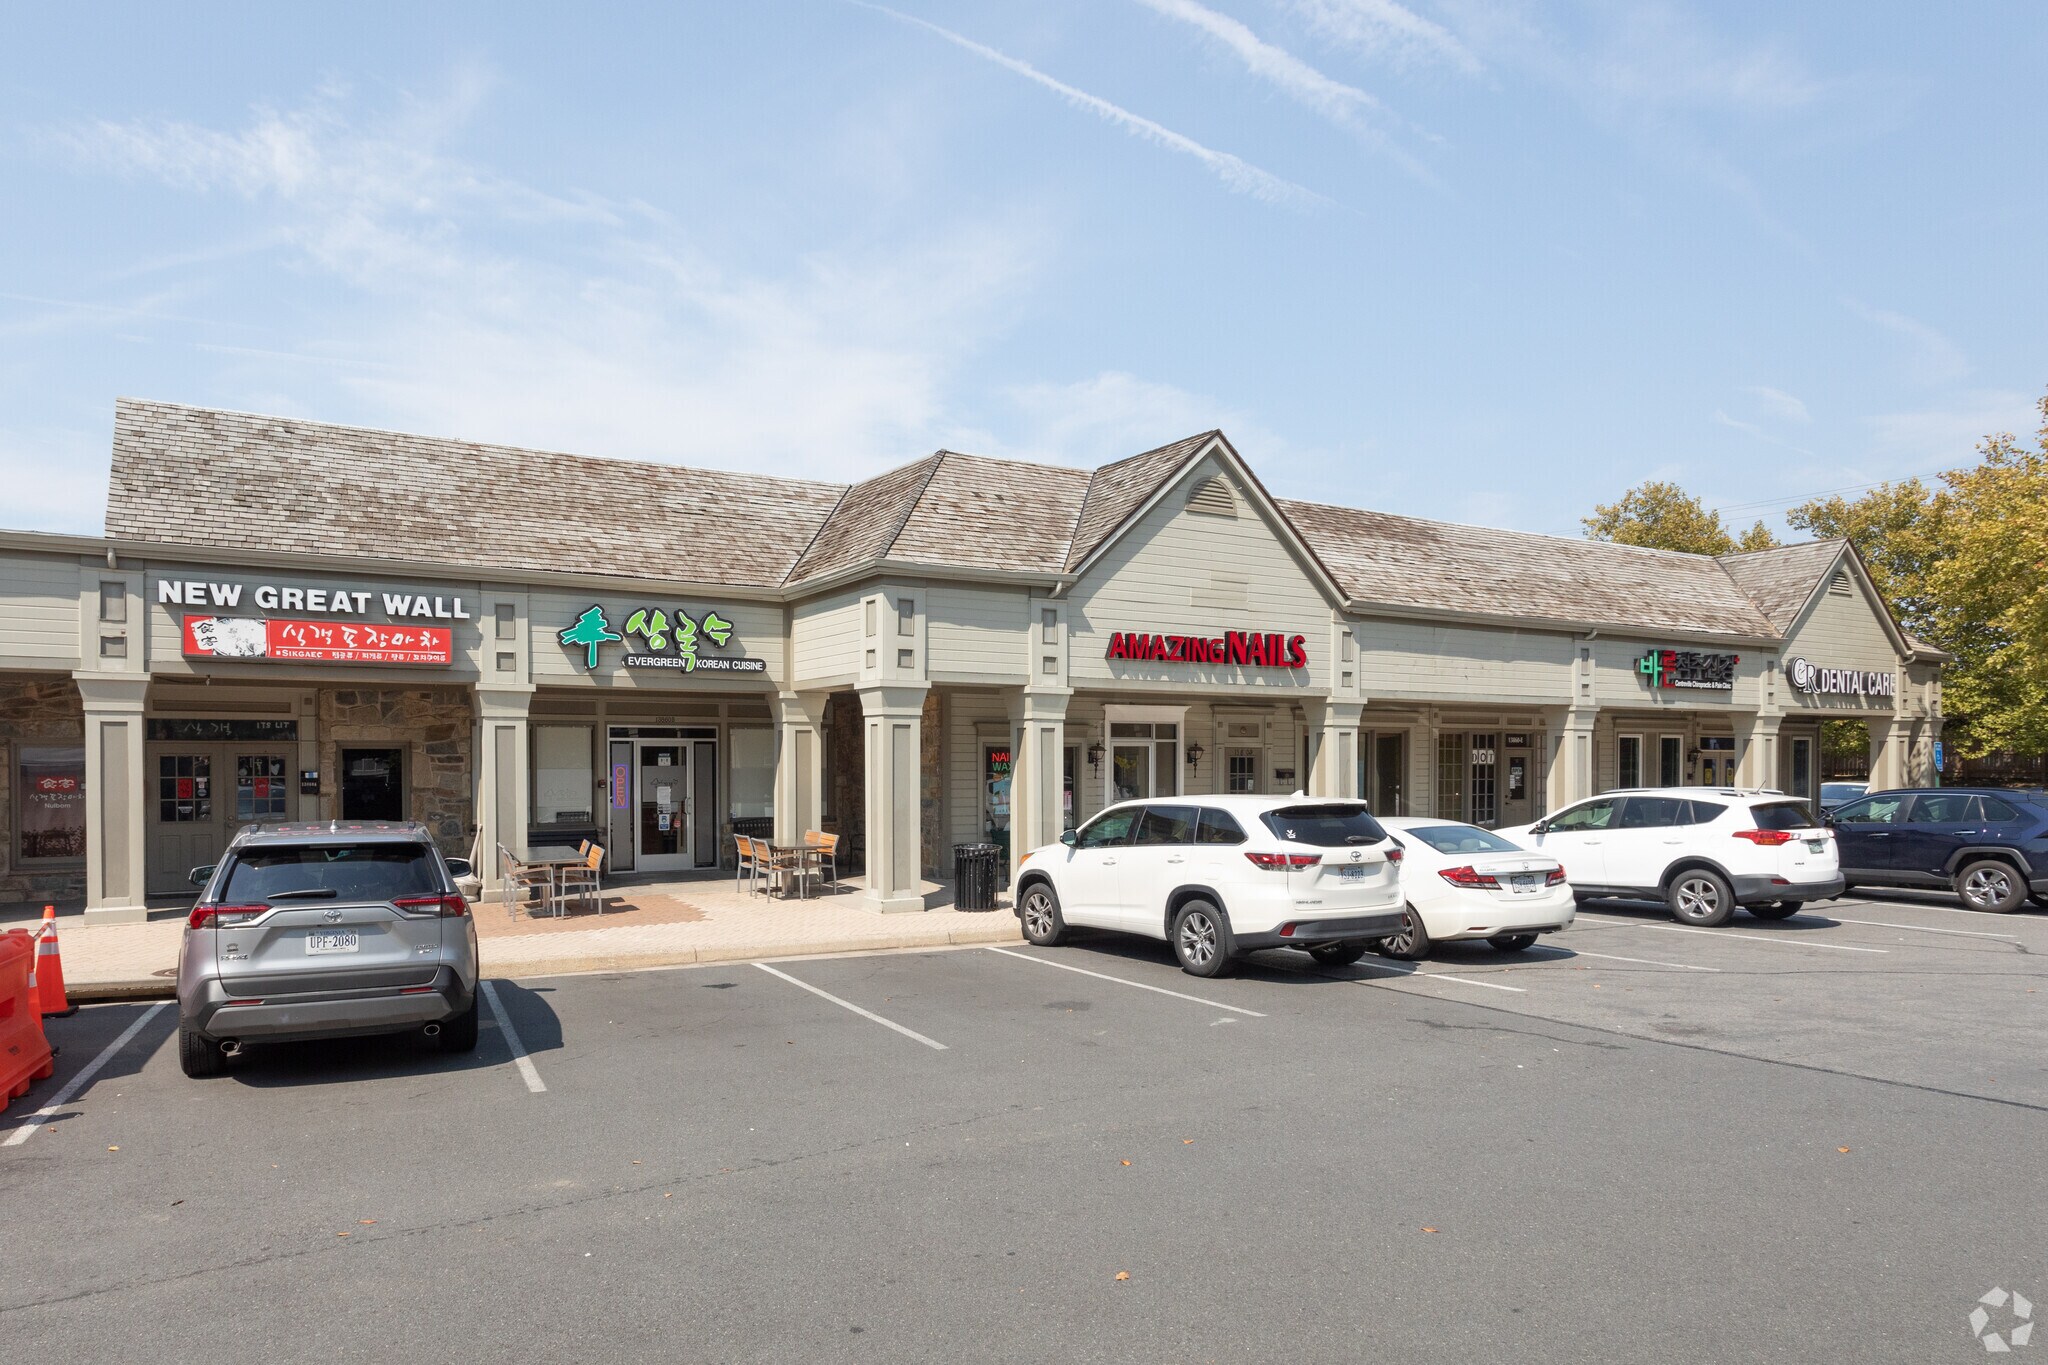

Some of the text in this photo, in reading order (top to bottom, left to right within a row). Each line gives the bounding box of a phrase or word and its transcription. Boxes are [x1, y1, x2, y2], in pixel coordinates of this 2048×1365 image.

[158, 580, 470, 619] NEW GREAT WALL
[282, 649, 323, 659] SIKGAEC
[1106, 630, 1308, 668] AMAZING NAILS
[628, 656, 764, 671] EVERGREEN KOREAN CUISINE
[1821, 668, 1867, 694] DENTAL
[1868, 671, 1896, 696] CARE
[615, 767, 626, 807] OPEN
[310, 934, 357, 949] UPF-2080
